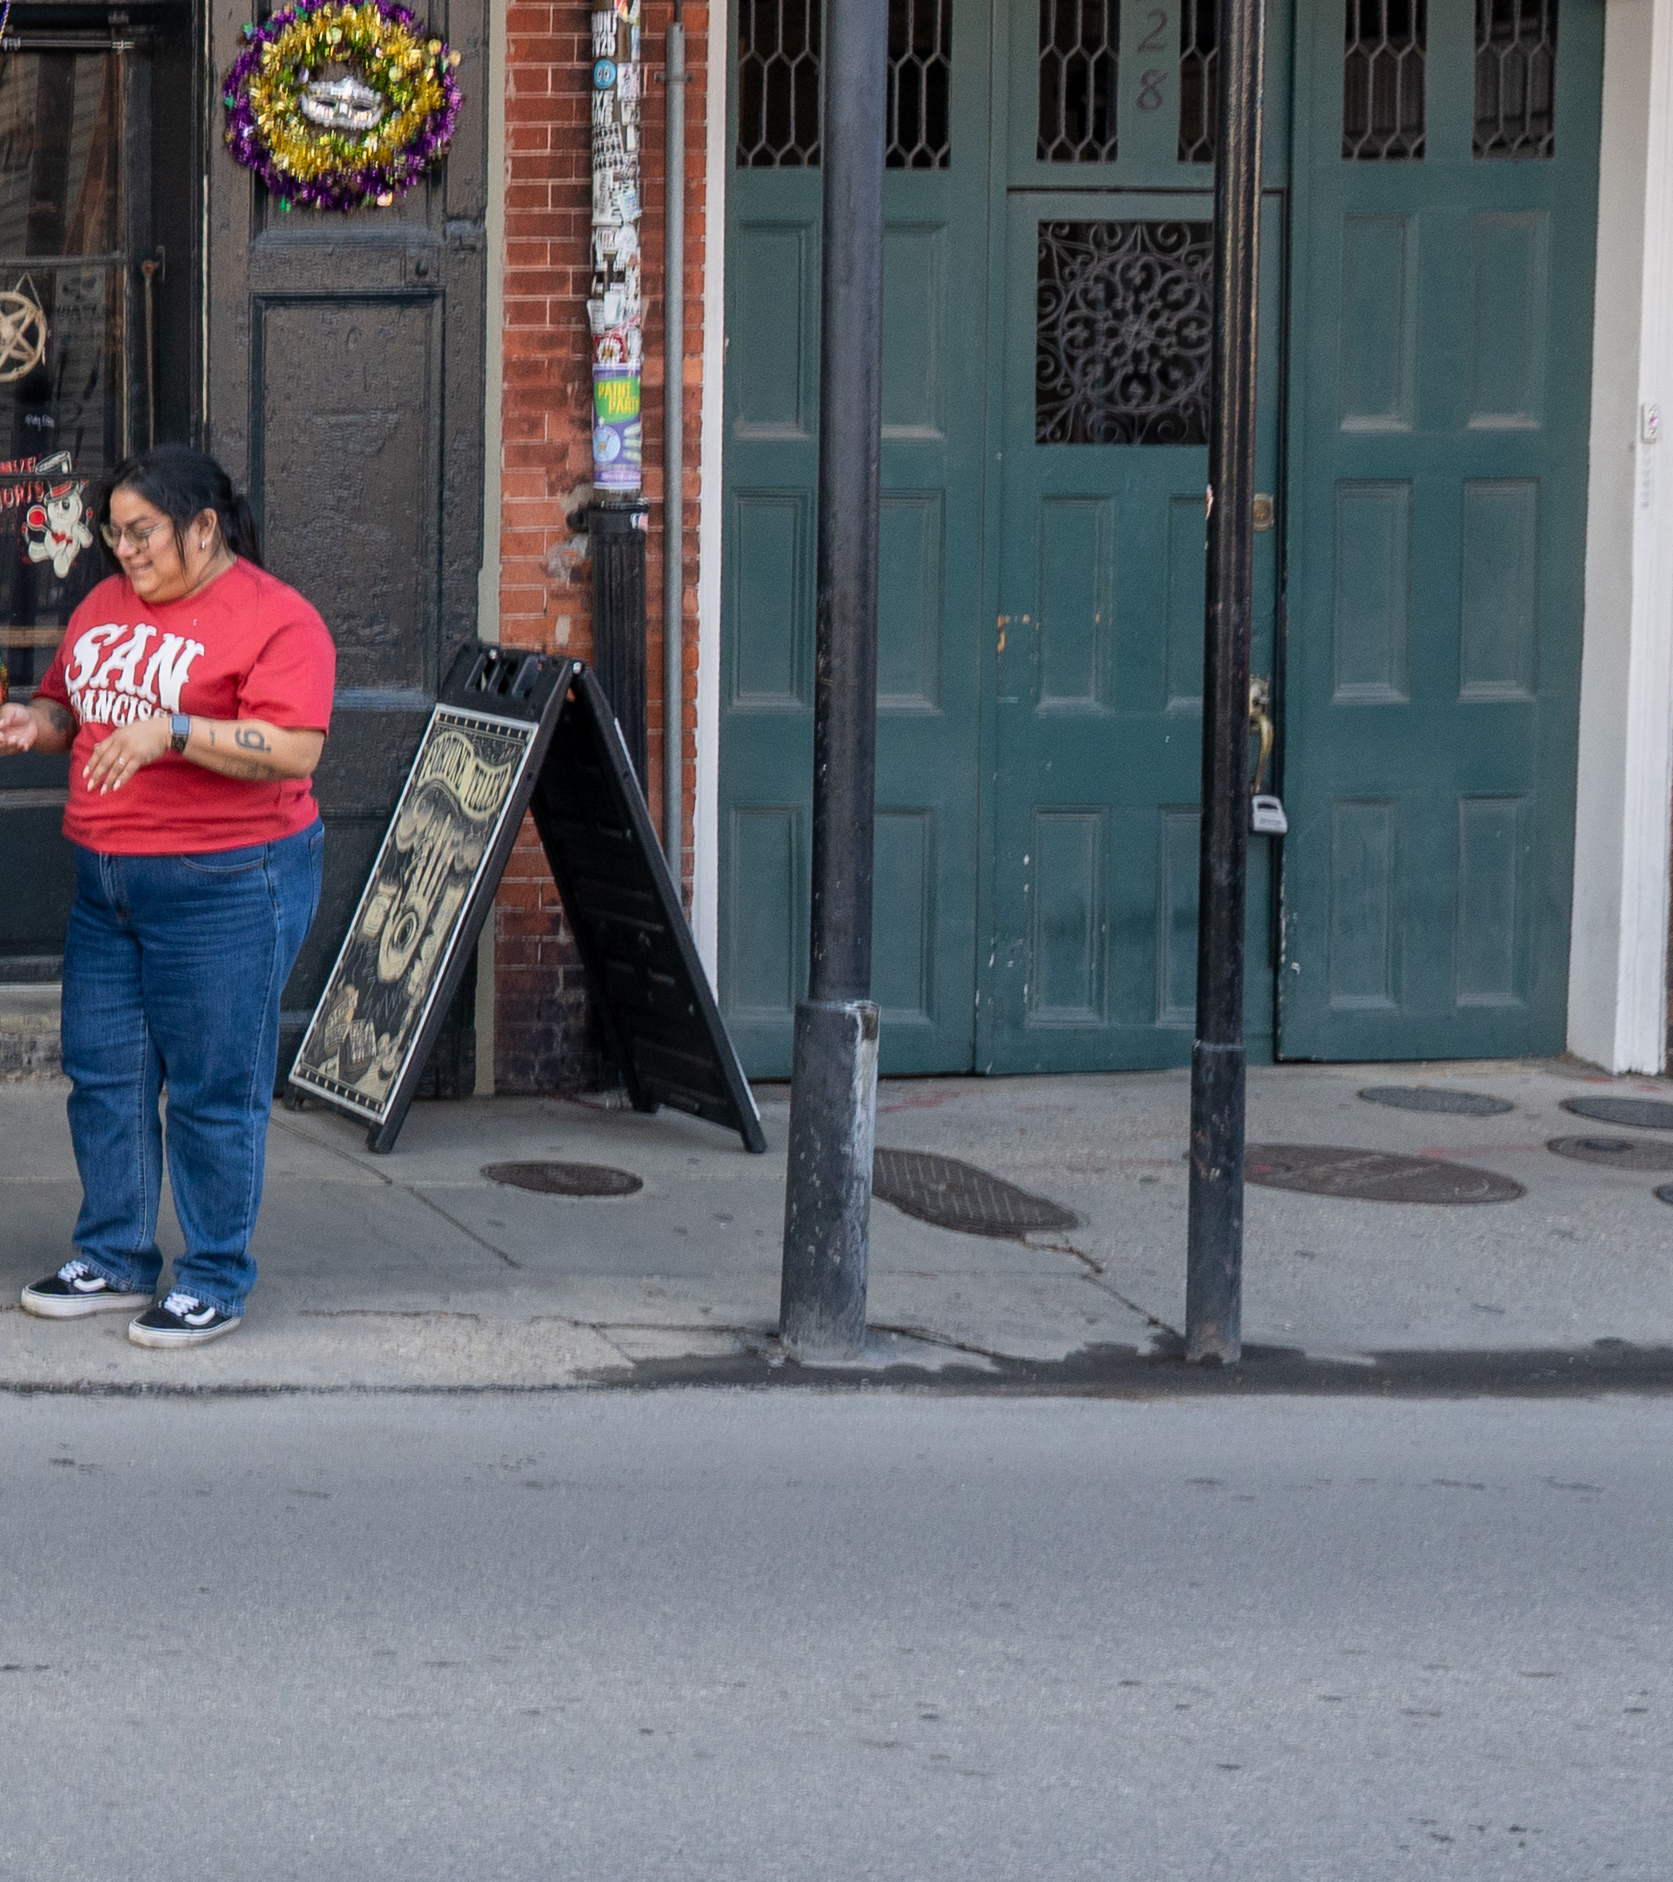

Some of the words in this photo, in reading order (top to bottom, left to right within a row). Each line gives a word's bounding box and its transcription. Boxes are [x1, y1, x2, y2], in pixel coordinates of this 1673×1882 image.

[64, 622, 205, 714] SAN
[419, 732, 474, 791] FORTUNE
[462, 758, 512, 814] TELLER
